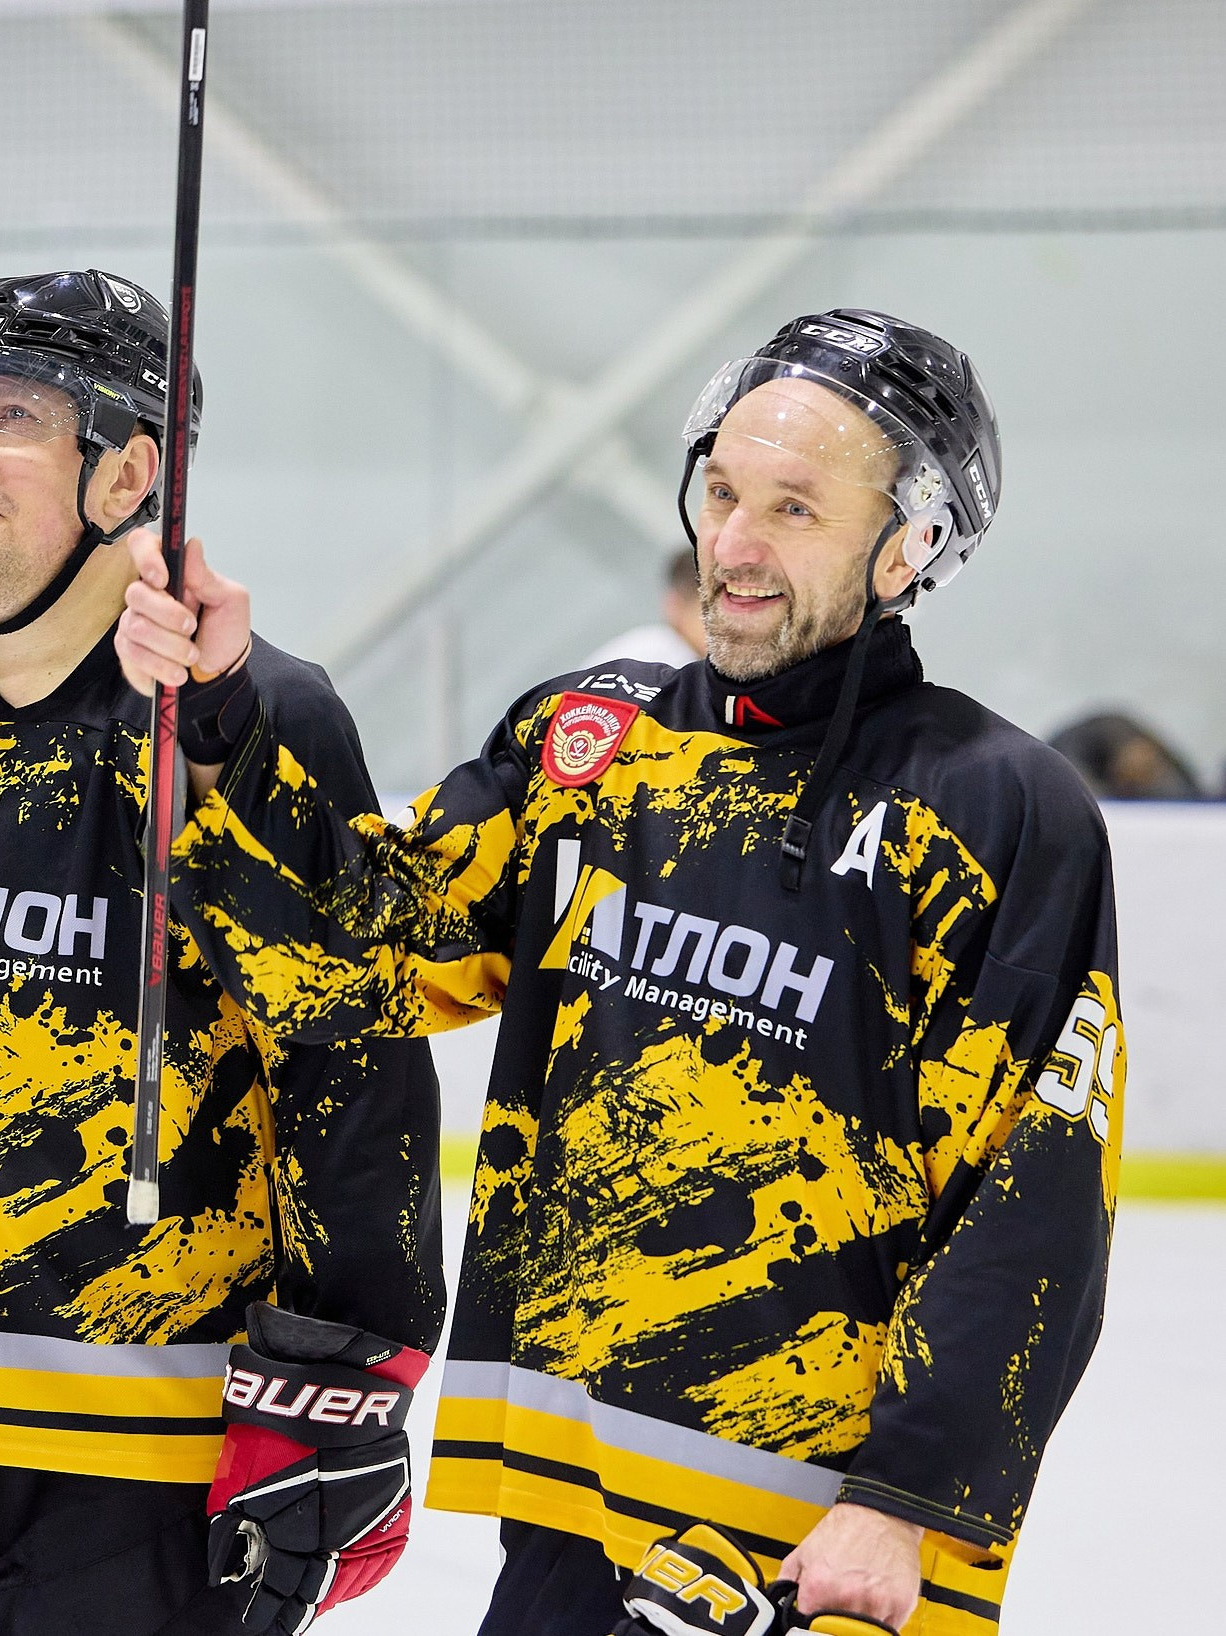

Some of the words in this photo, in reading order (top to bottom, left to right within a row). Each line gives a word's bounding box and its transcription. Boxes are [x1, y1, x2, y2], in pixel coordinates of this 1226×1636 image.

[799, 323, 876, 353] CCM
[141, 368, 168, 392] CC
[968, 463, 992, 519] CCM
[830, 801, 888, 891] A
[623, 975, 810, 1051] Management
